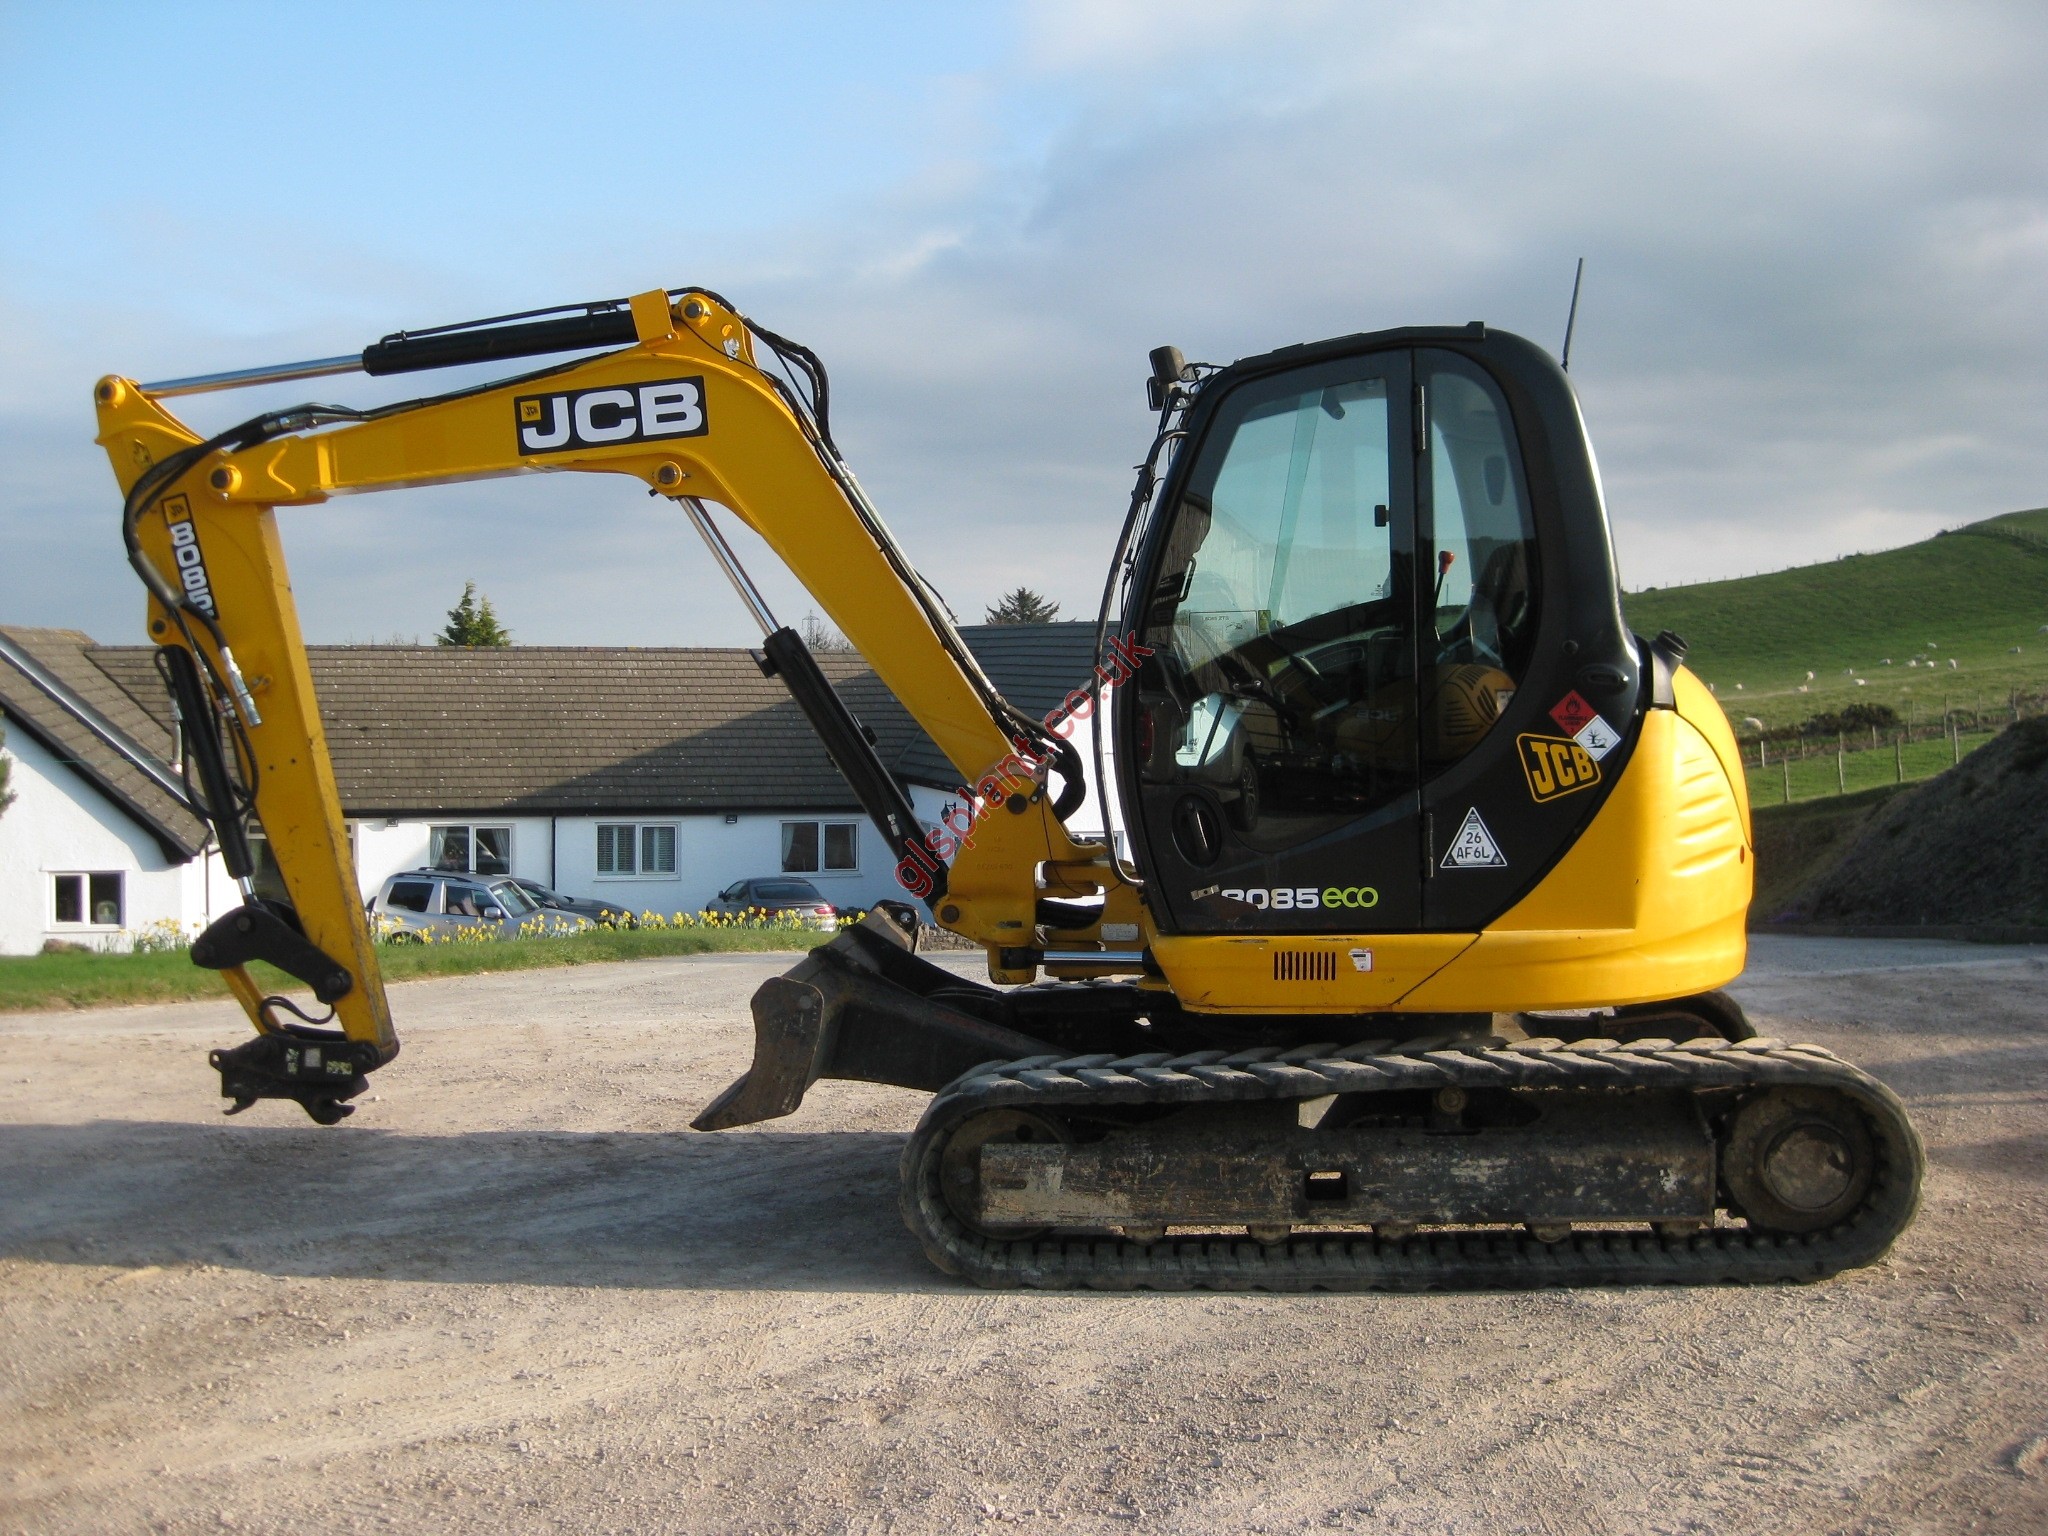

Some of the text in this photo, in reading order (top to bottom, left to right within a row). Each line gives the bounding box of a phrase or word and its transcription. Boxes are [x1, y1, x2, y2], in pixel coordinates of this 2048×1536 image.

[522, 383, 703, 449] JCB
[170, 521, 213, 610] 8085
[1530, 741, 1594, 795] JCB
[1456, 846, 1490, 859] AF6L
[1465, 831, 1482, 844] 26
